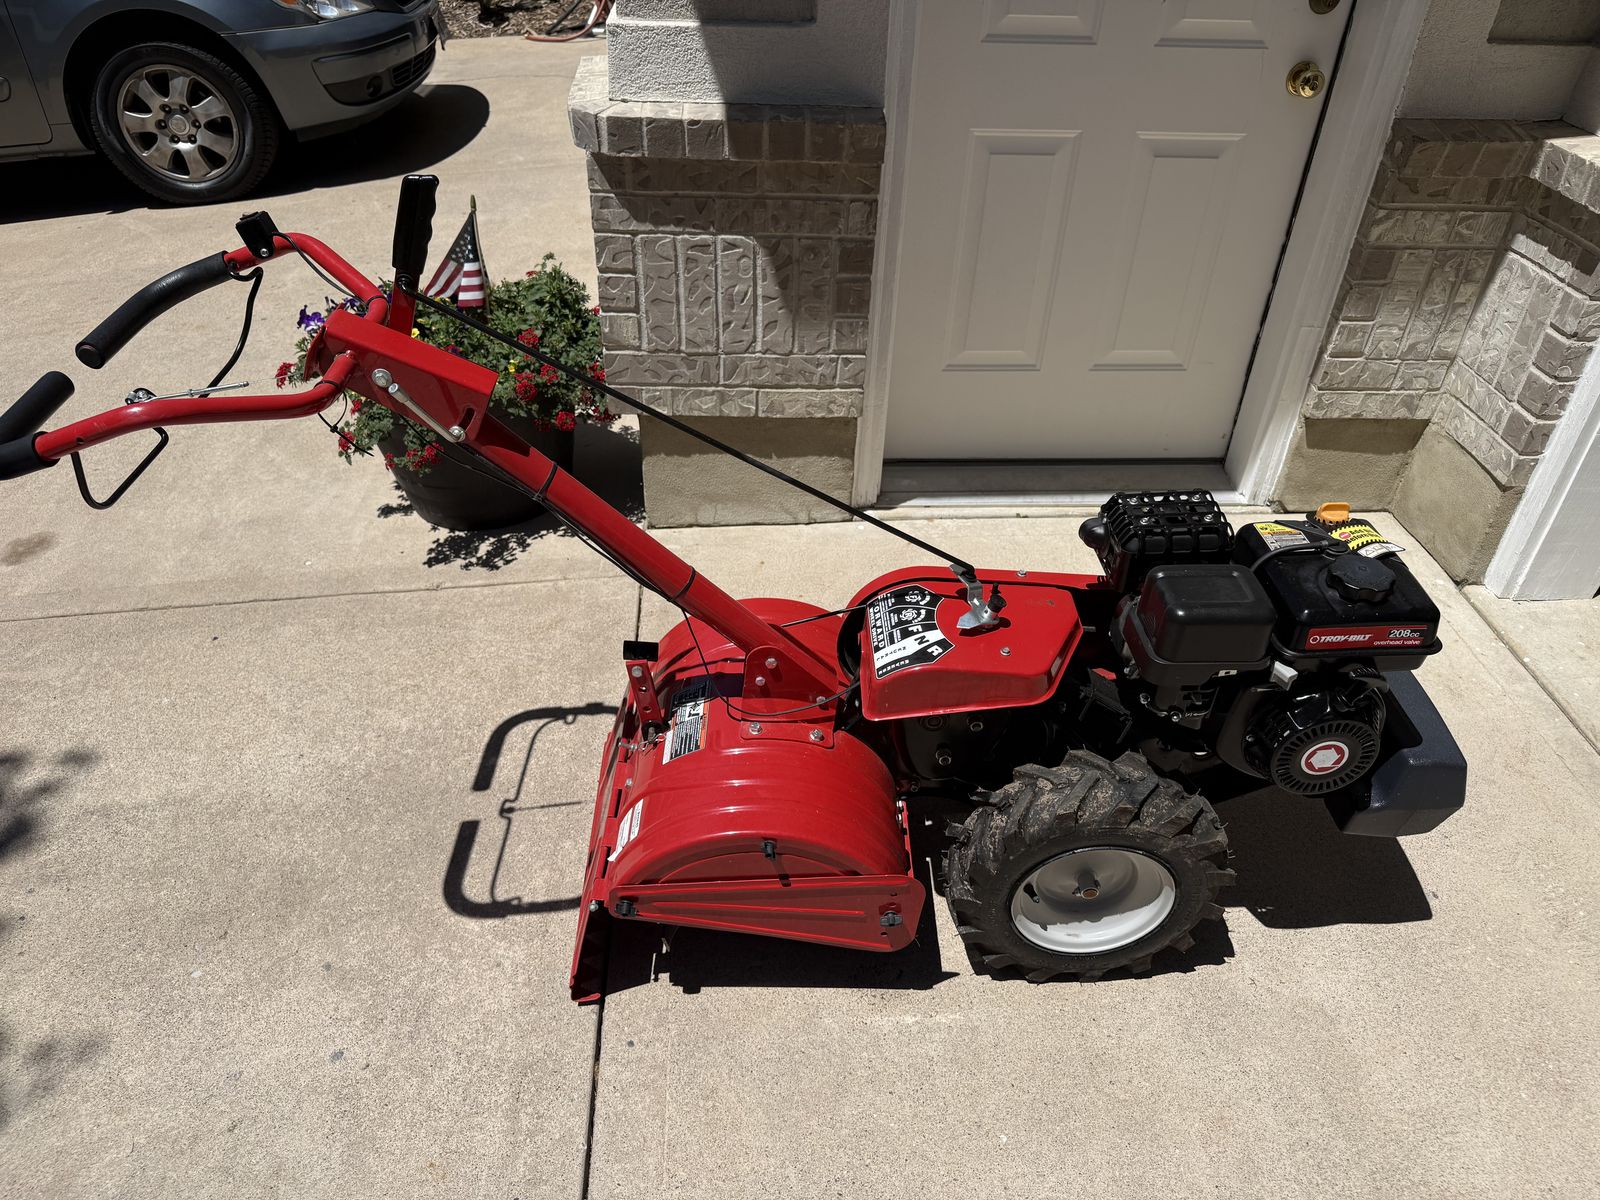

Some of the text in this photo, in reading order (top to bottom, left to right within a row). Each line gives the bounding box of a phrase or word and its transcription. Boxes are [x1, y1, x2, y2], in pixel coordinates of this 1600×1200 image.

[873, 601, 885, 648] FORWARD
[908, 625, 923, 633] F
[871, 627, 879, 647] DRIVE
[914, 635, 930, 646] N
[1320, 629, 1420, 643] TROY-BILT 208cc
[926, 644, 943, 656] R
